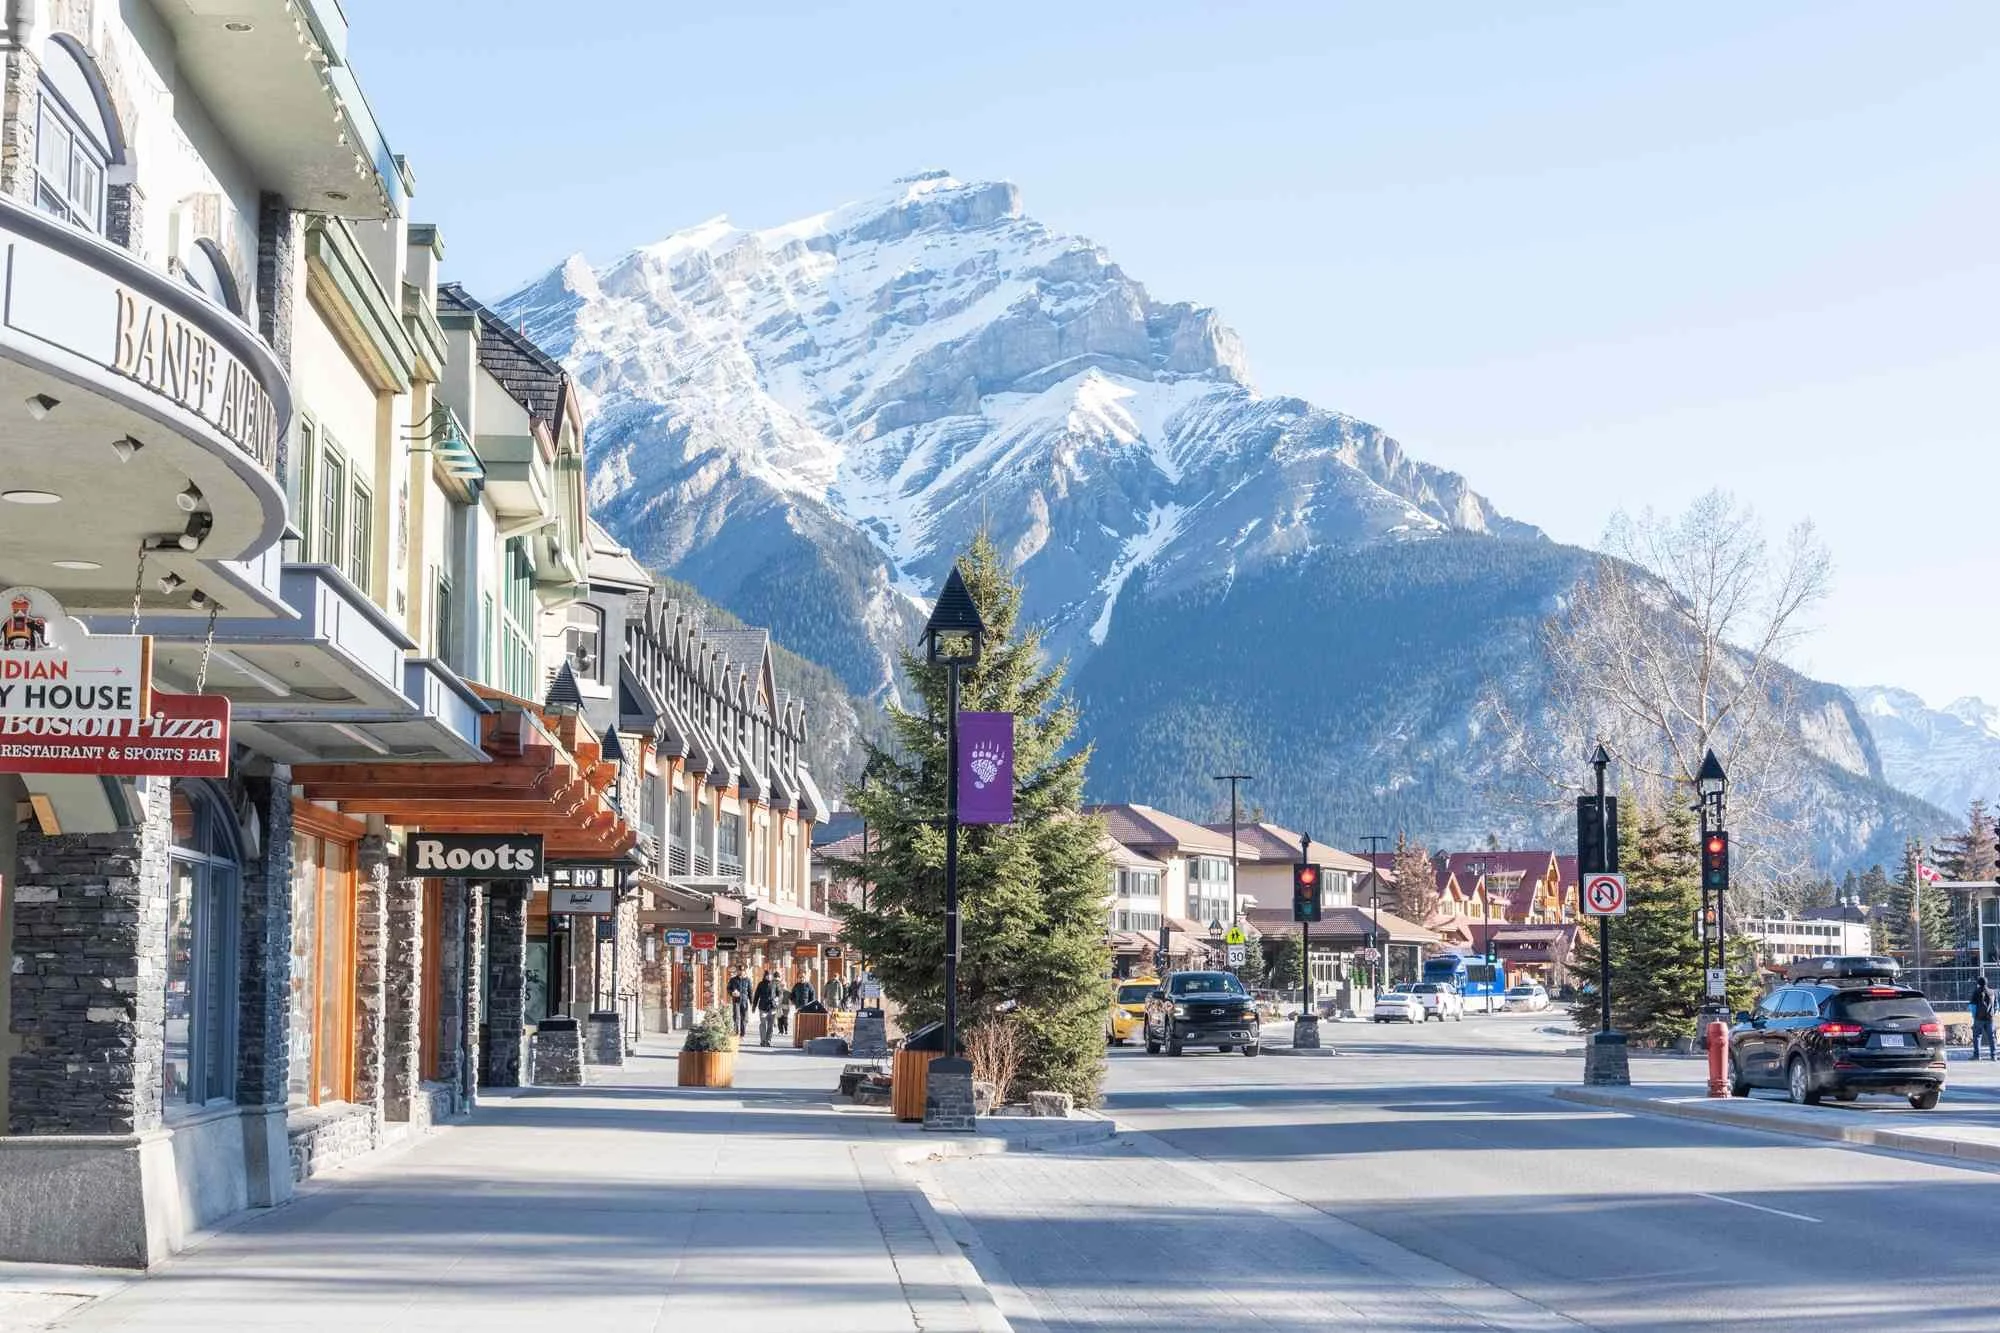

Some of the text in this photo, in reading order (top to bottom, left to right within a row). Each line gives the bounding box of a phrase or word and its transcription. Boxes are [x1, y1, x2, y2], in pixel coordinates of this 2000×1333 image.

[114, 288, 217, 414] BANFF
[0, 660, 68, 680] DIAN
[25, 684, 132, 710] HOUSE
[127, 711, 222, 740] Pizza
[0, 744, 221, 763] RESTAURANT & SPORTS BAR
[416, 840, 534, 871] Roots
[1230, 951, 1244, 963] 30
